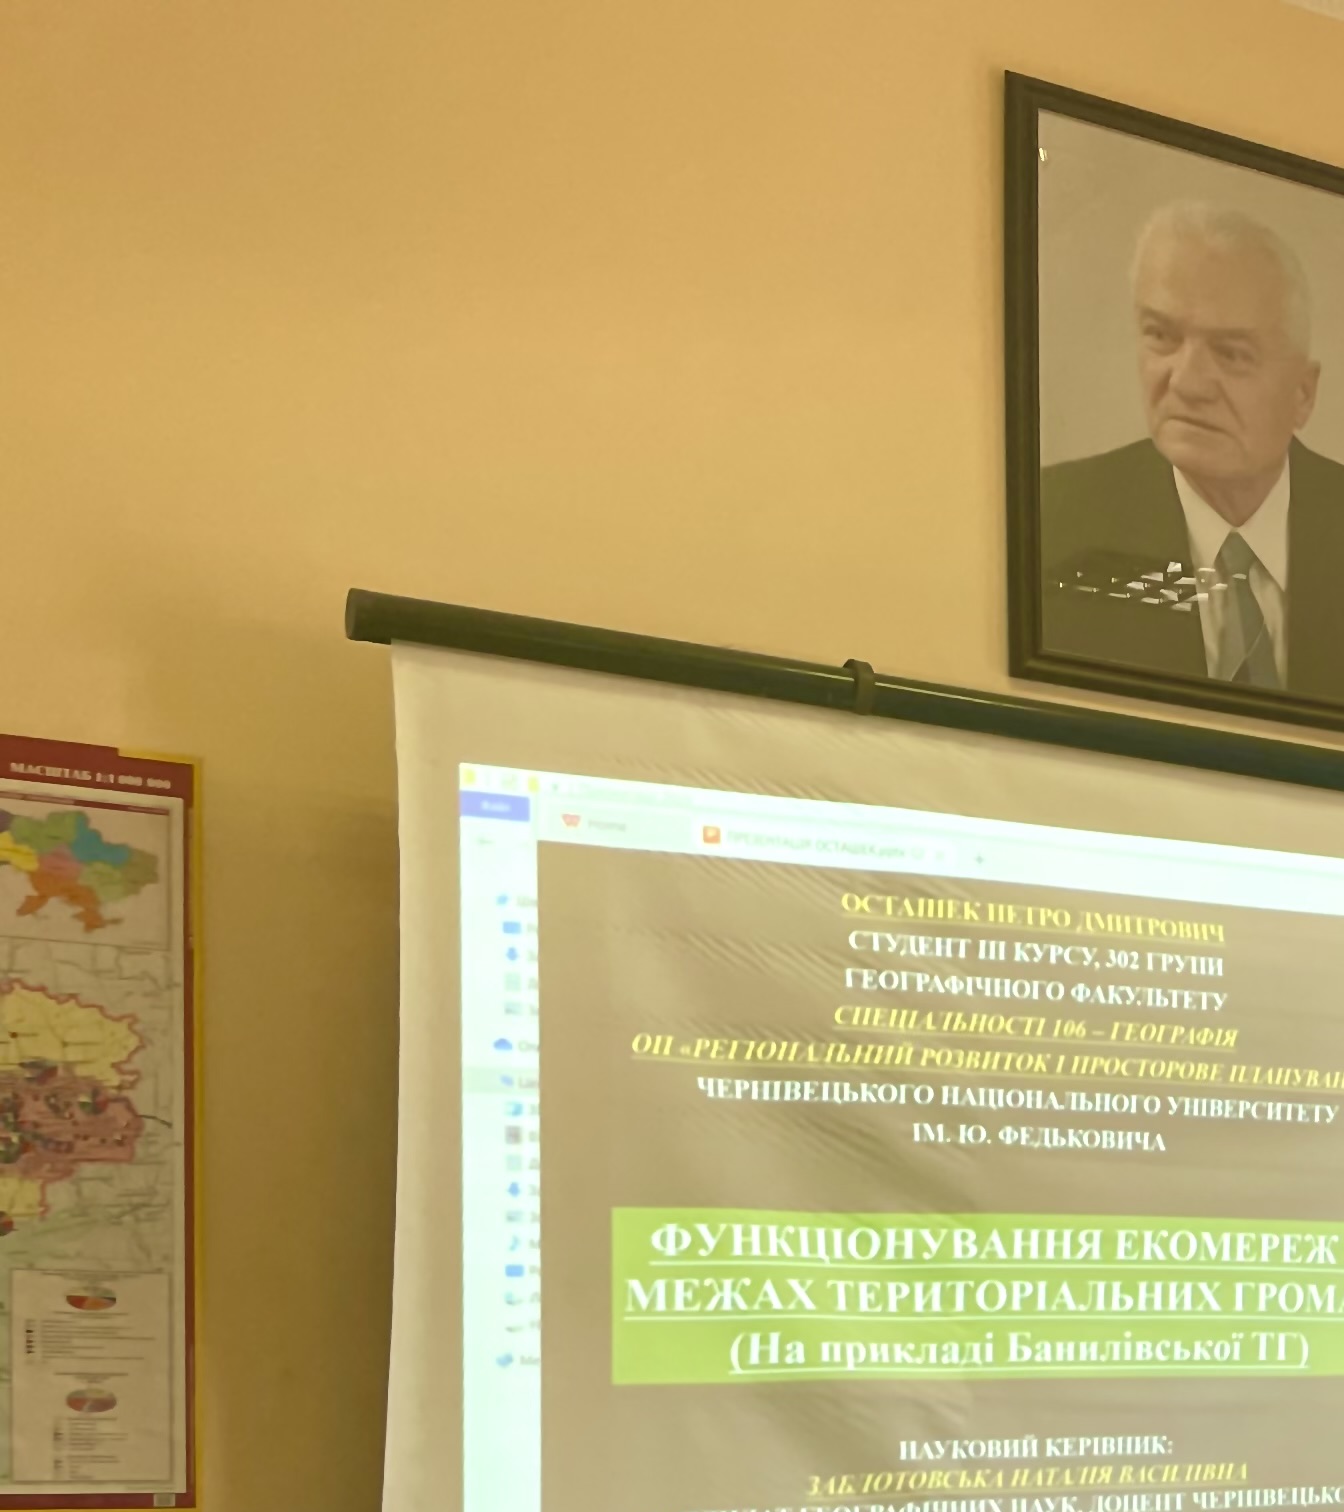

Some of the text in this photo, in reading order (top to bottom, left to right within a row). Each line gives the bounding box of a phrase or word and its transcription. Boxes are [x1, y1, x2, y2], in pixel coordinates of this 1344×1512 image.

[841, 892, 1225, 943] ОСТАШЕК ПЕТРО ДМИТРОВИЧ
[848, 929, 970, 959] СТУДЕНТ
[1014, 942, 1101, 971] КУРСУ,
[1105, 948, 1140, 971] 302
[1146, 951, 1224, 976] ГРУПИ
[844, 966, 1227, 1011] ГЕОГРАФІЧНОГО ФАКУЛЬТЕТУ
[834, 1005, 1045, 1036] СПЕЦІАЛЬНОСТІ
[1052, 1018, 1086, 1039] 106
[1110, 1021, 1239, 1048] ГЕОГРАФІЯ
[631, 1032, 674, 1056] ОП
[679, 1038, 915, 1066] «РЕГІОНАЛЬНИЙ
[920, 1047, 1050, 1073] РОЗВИТОК
[1071, 1055, 1223, 1082] ПРОСТОРОВЕ
[697, 1076, 1340, 1124] ЧЕРНІВЕЦЬКОГО НАЦІОНАЛЬНОГО УНІВЕРСИТЕТУ
[912, 1123, 1166, 1151] ІМ. Ю. ФЕДЬКОВИЧА
[649, 1220, 1102, 1262] ФУНКЦІОНУВАННЯ
[1115, 1228, 1339, 1264] ЕКОМЕРЕЖ
[624, 1277, 818, 1313] МЕЖАХ
[827, 1278, 1223, 1314] ТЕРИТОРІАЛЬНИХ
[730, 1331, 1310, 1372] (На прикладі Банилівської ТГ)
[900, 1434, 1173, 1460] НАУКОВИЙ КЕРІВНИК:
[806, 1462, 1248, 1496] ЗАБЛОТОВСЬКА НАТАЛІЯ ВАСИЛІВНА
